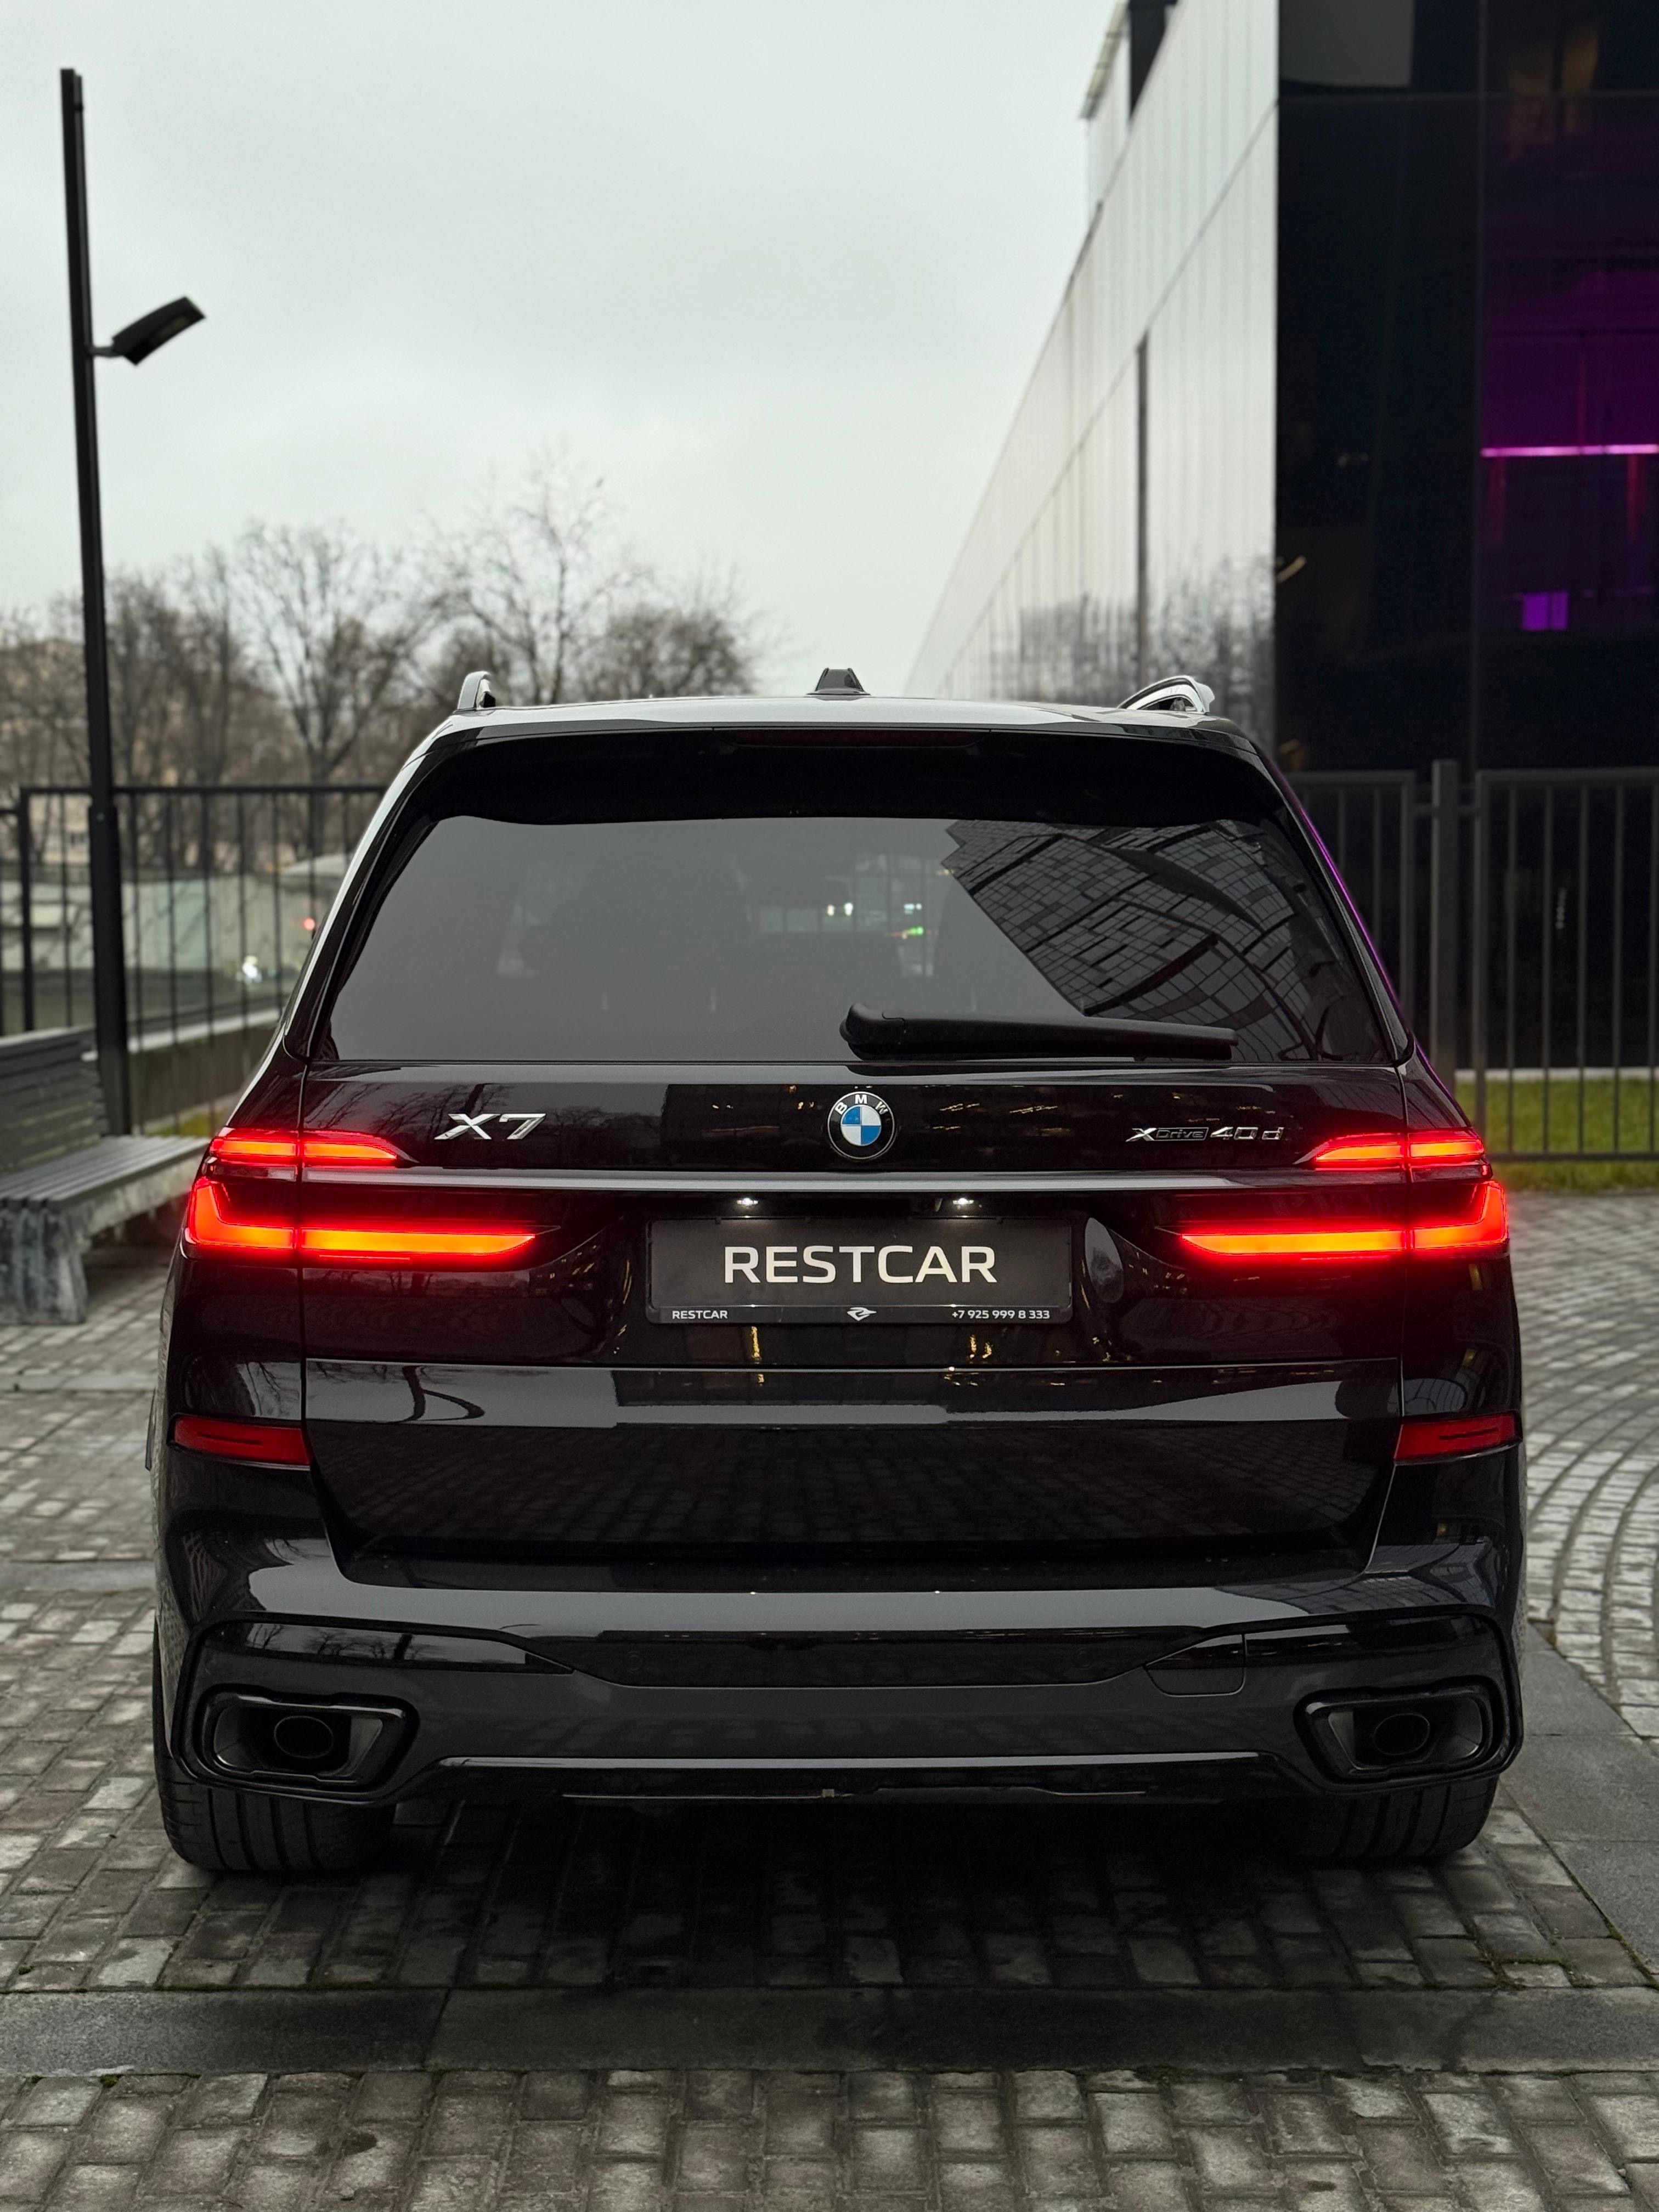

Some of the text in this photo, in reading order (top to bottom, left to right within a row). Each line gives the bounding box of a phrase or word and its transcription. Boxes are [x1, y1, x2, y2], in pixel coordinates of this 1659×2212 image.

[834, 1094, 888, 1115] BMW
[433, 1113, 546, 1140] X7
[725, 1245, 997, 1283] RESTCAR
[673, 1310, 727, 1319] RESTCAR
[952, 1310, 964, 1318] +7
[968, 1310, 989, 1318] 925
[992, 1310, 1015, 1318] 999
[1029, 1311, 1049, 1319] 333
